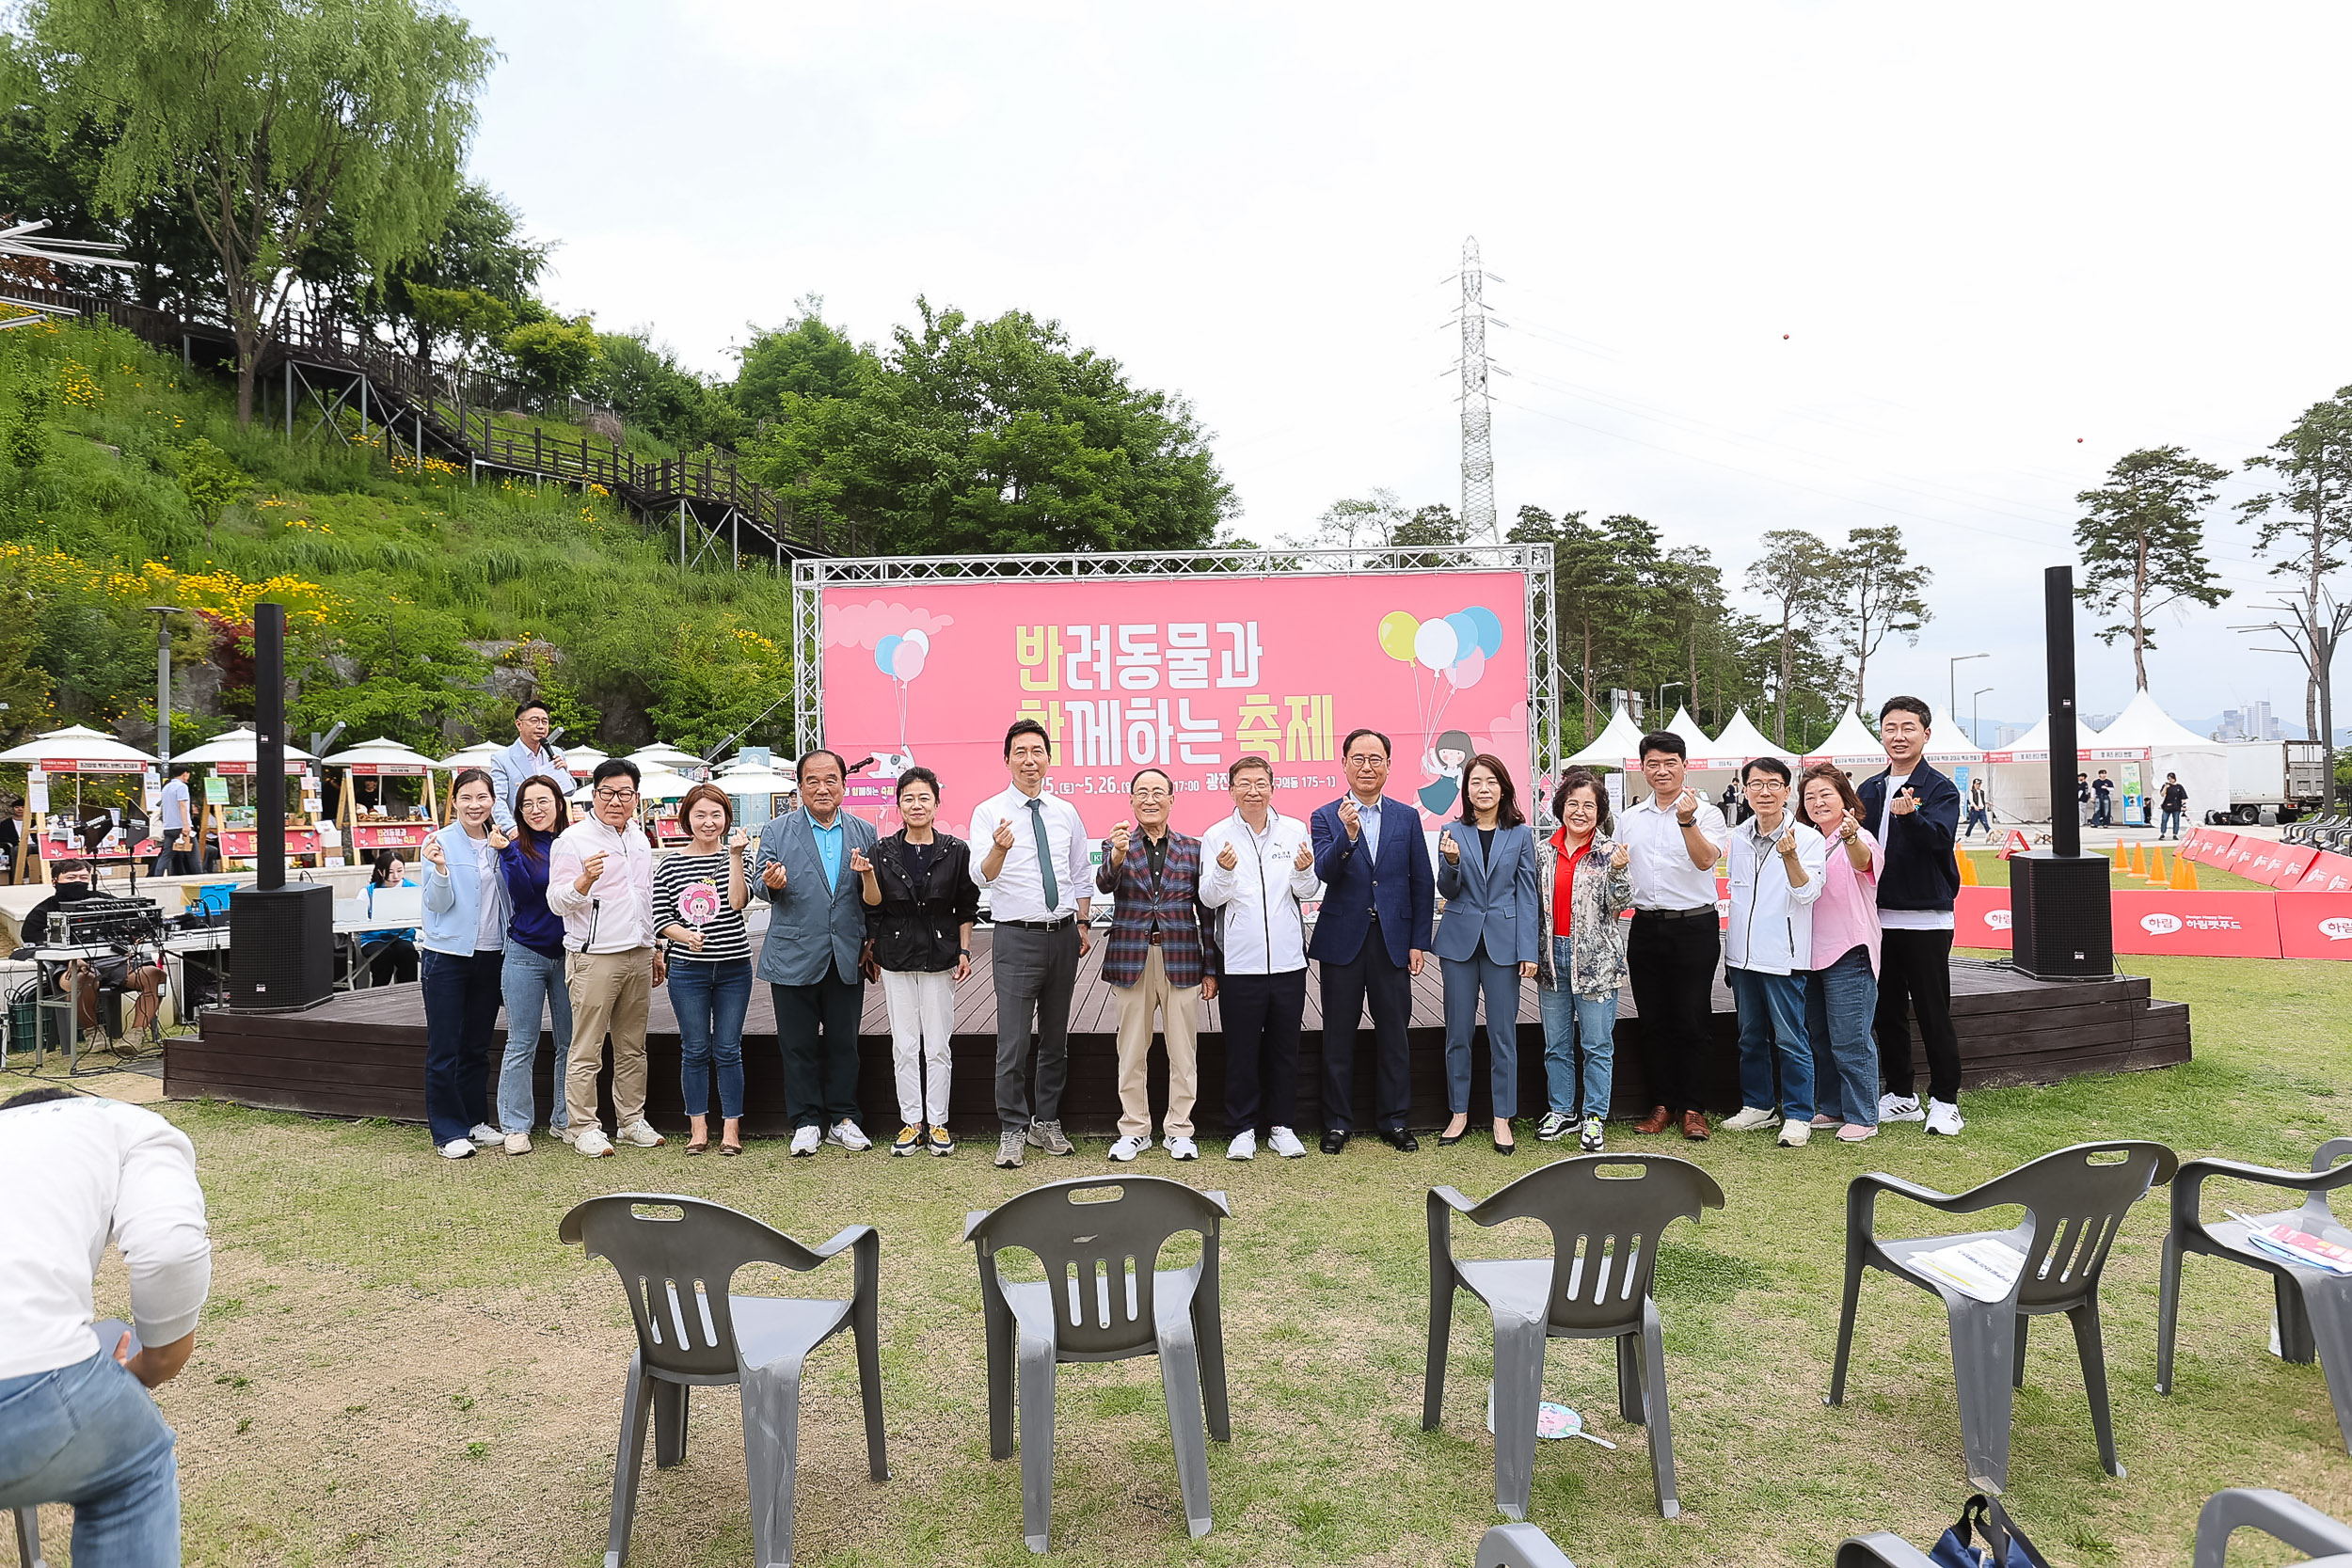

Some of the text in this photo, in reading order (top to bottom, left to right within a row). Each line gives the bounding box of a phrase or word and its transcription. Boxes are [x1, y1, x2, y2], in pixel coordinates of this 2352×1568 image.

[1015, 621, 1264, 691] 반려동물과
[1235, 693, 1335, 763] 축제
[1302, 775, 1336, 788] 175-1)
[2148, 917, 2173, 928] 하림
[2185, 919, 2243, 930] 하림펫푸드
